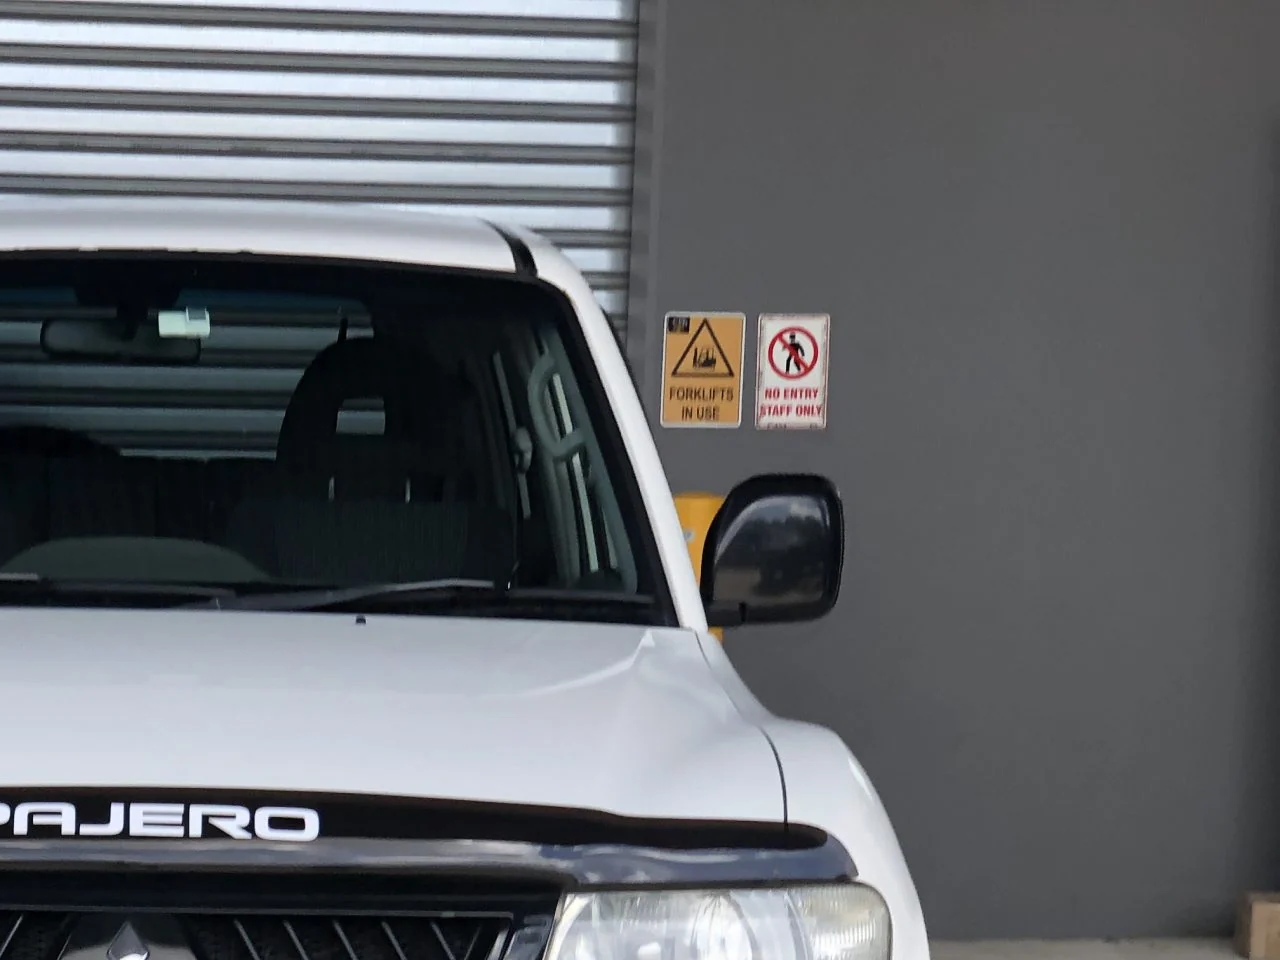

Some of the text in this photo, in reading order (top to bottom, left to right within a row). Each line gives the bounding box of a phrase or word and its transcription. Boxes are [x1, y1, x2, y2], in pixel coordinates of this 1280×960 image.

[670, 386, 734, 401] FORKLIFTS
[765, 387, 819, 400] NO ENTRY
[681, 405, 719, 420] IN USE
[759, 404, 823, 417] STAFF ONLY
